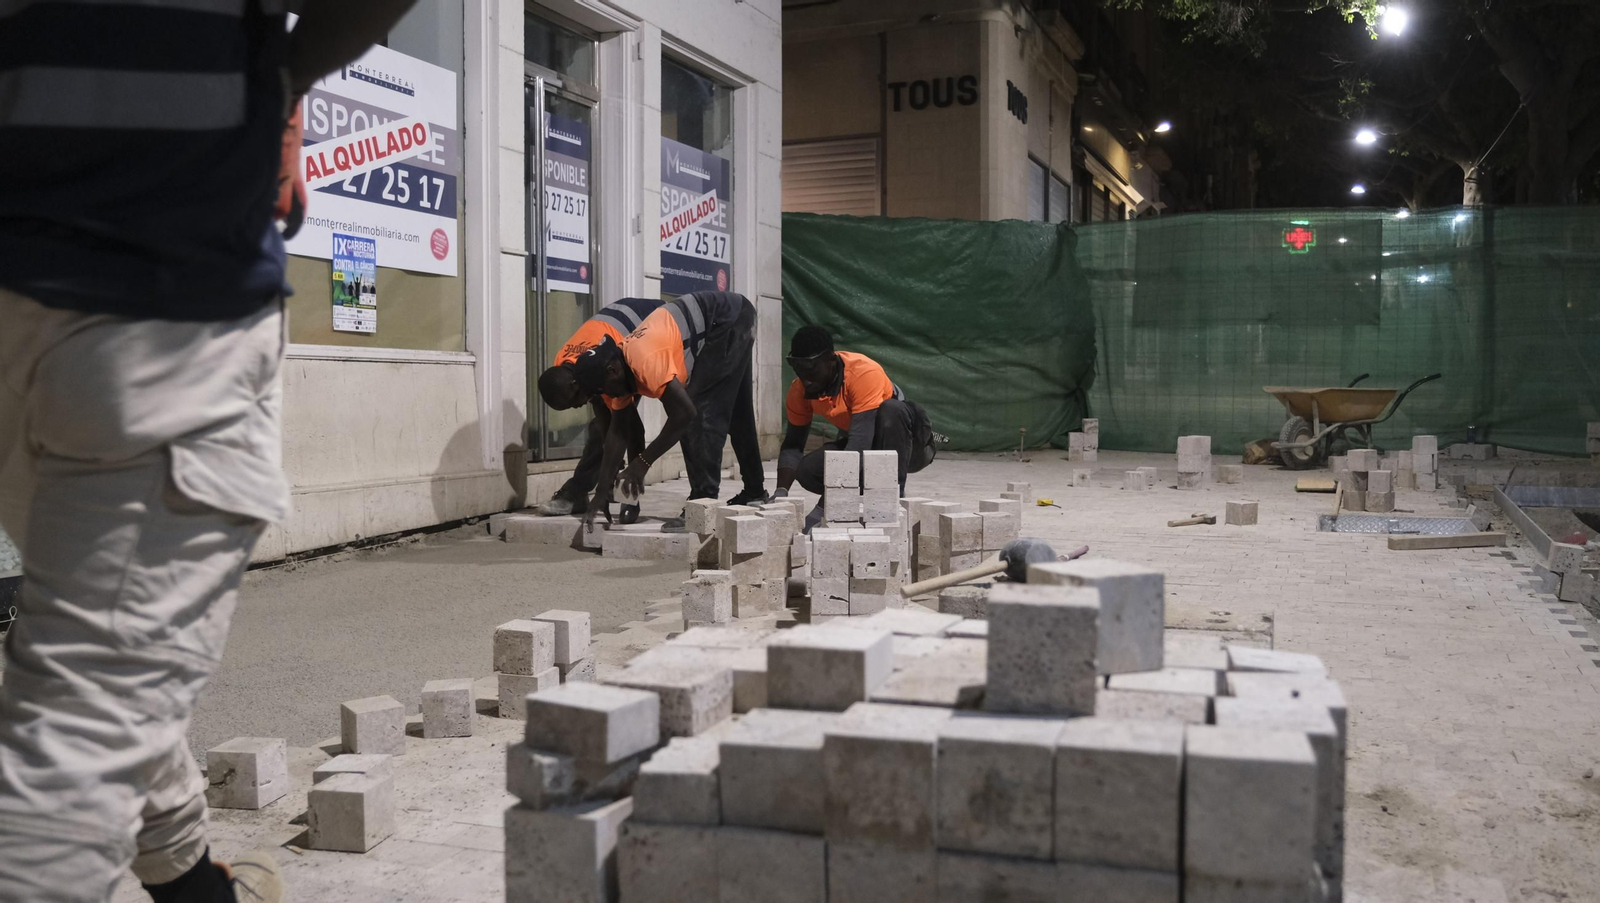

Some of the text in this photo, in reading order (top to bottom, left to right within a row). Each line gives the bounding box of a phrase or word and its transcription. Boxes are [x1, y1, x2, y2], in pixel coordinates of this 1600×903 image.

[350, 64, 415, 89] MONTERREAL
[888, 75, 978, 112] TOUS
[306, 122, 427, 182] ALQUILADO
[382, 166, 410, 203] 25
[419, 175, 445, 210] 17
[552, 192, 561, 212] 27
[564, 195, 574, 215] 25
[576, 199, 586, 217] 17
[660, 196, 716, 242] ALQUILADO
[334, 237, 375, 256] IX CARRERA
[695, 231, 708, 255] 25
[713, 235, 726, 259] 17
[334, 258, 354, 272] CONTRA
